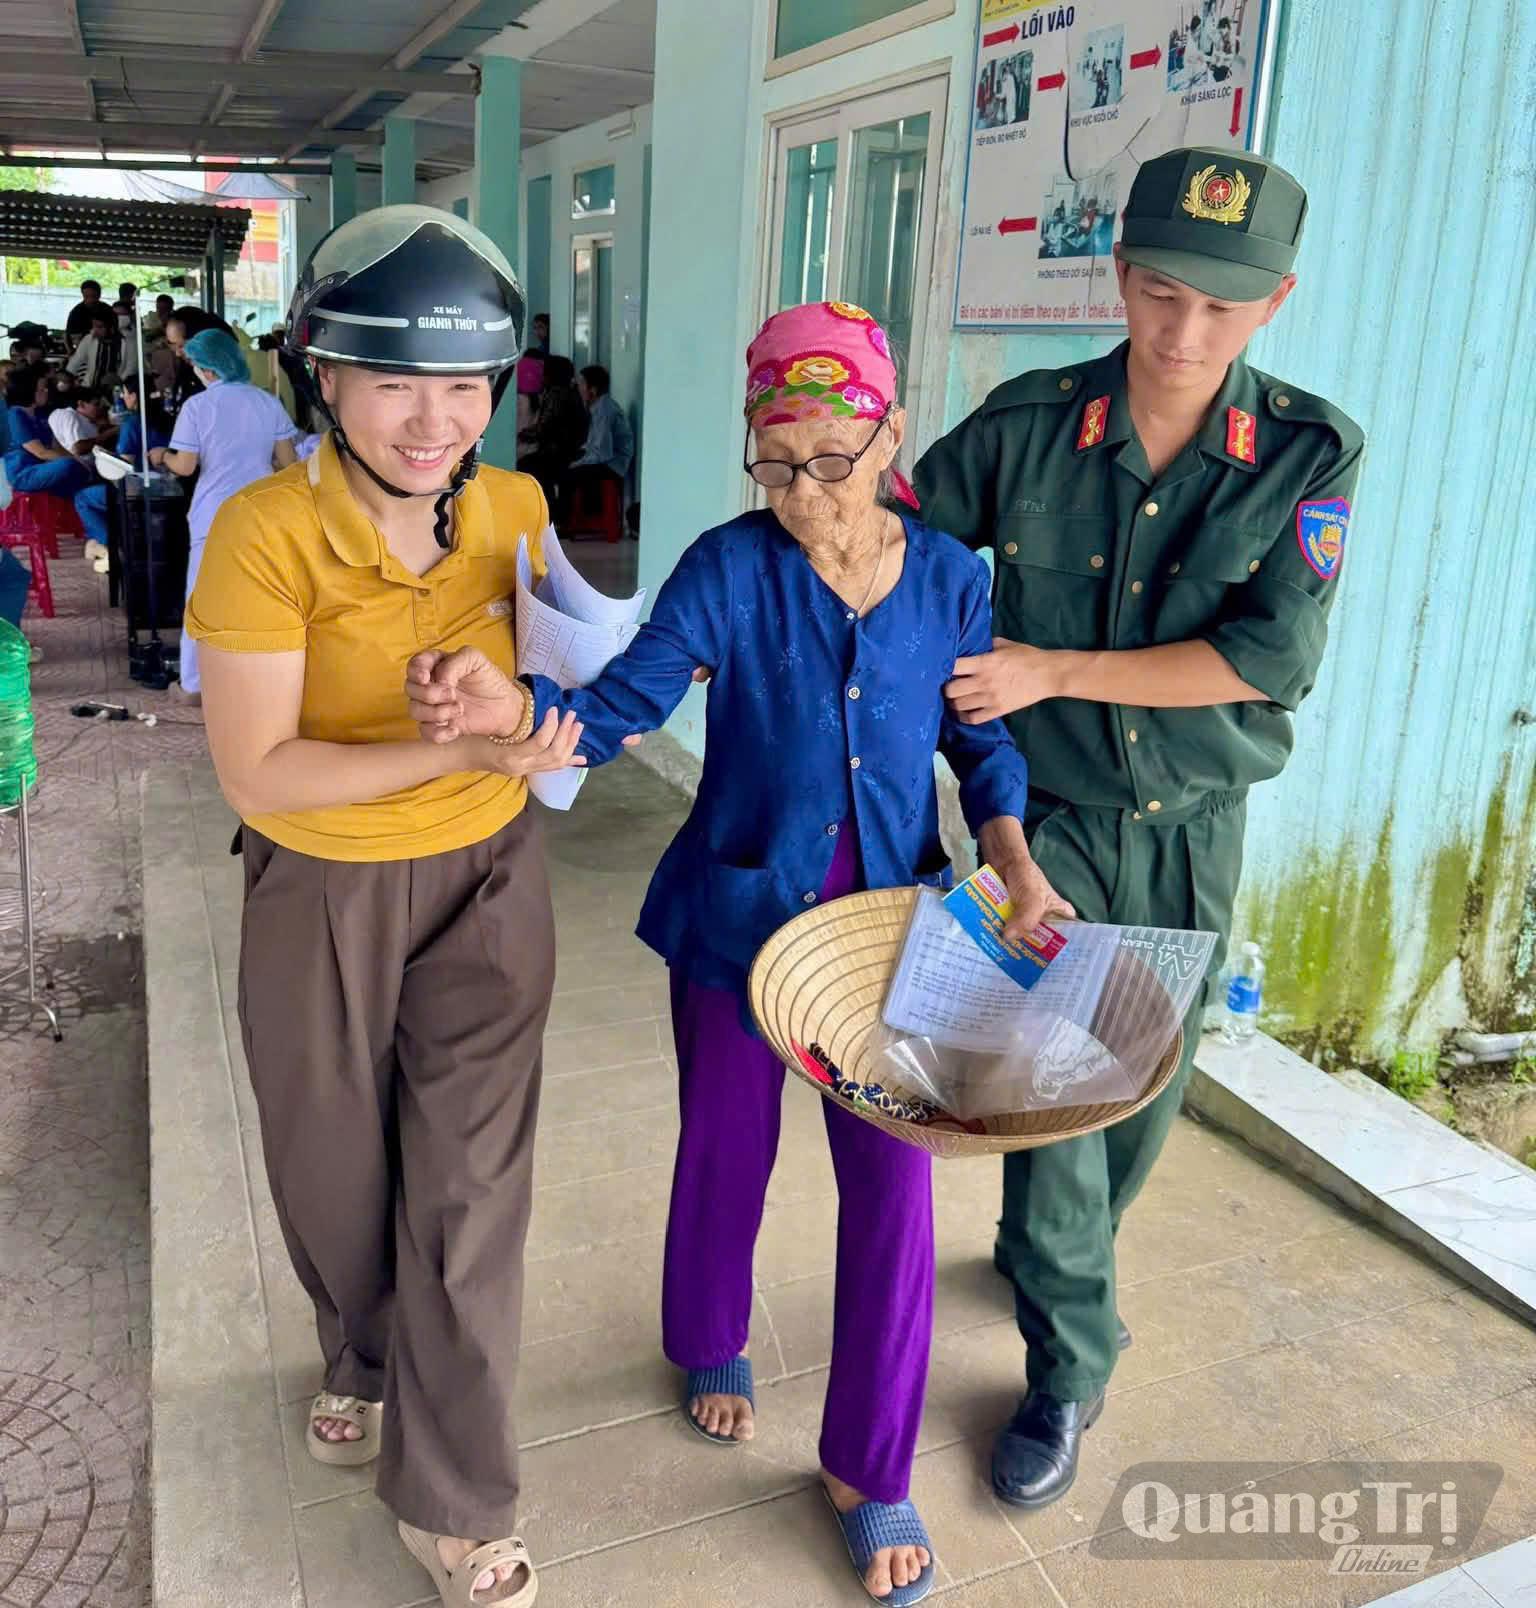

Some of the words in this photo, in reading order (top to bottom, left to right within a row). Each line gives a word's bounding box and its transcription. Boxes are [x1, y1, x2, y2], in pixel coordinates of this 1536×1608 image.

[1021, 9, 1043, 40] LỐI
[1047, 5, 1075, 32] VÀO
[433, 306, 444, 314] XE
[445, 305, 463, 315] MÁY
[417, 316, 452, 330] GIANH
[1121, 938, 1155, 950] CLEAR
[1158, 943, 1206, 980] A4
